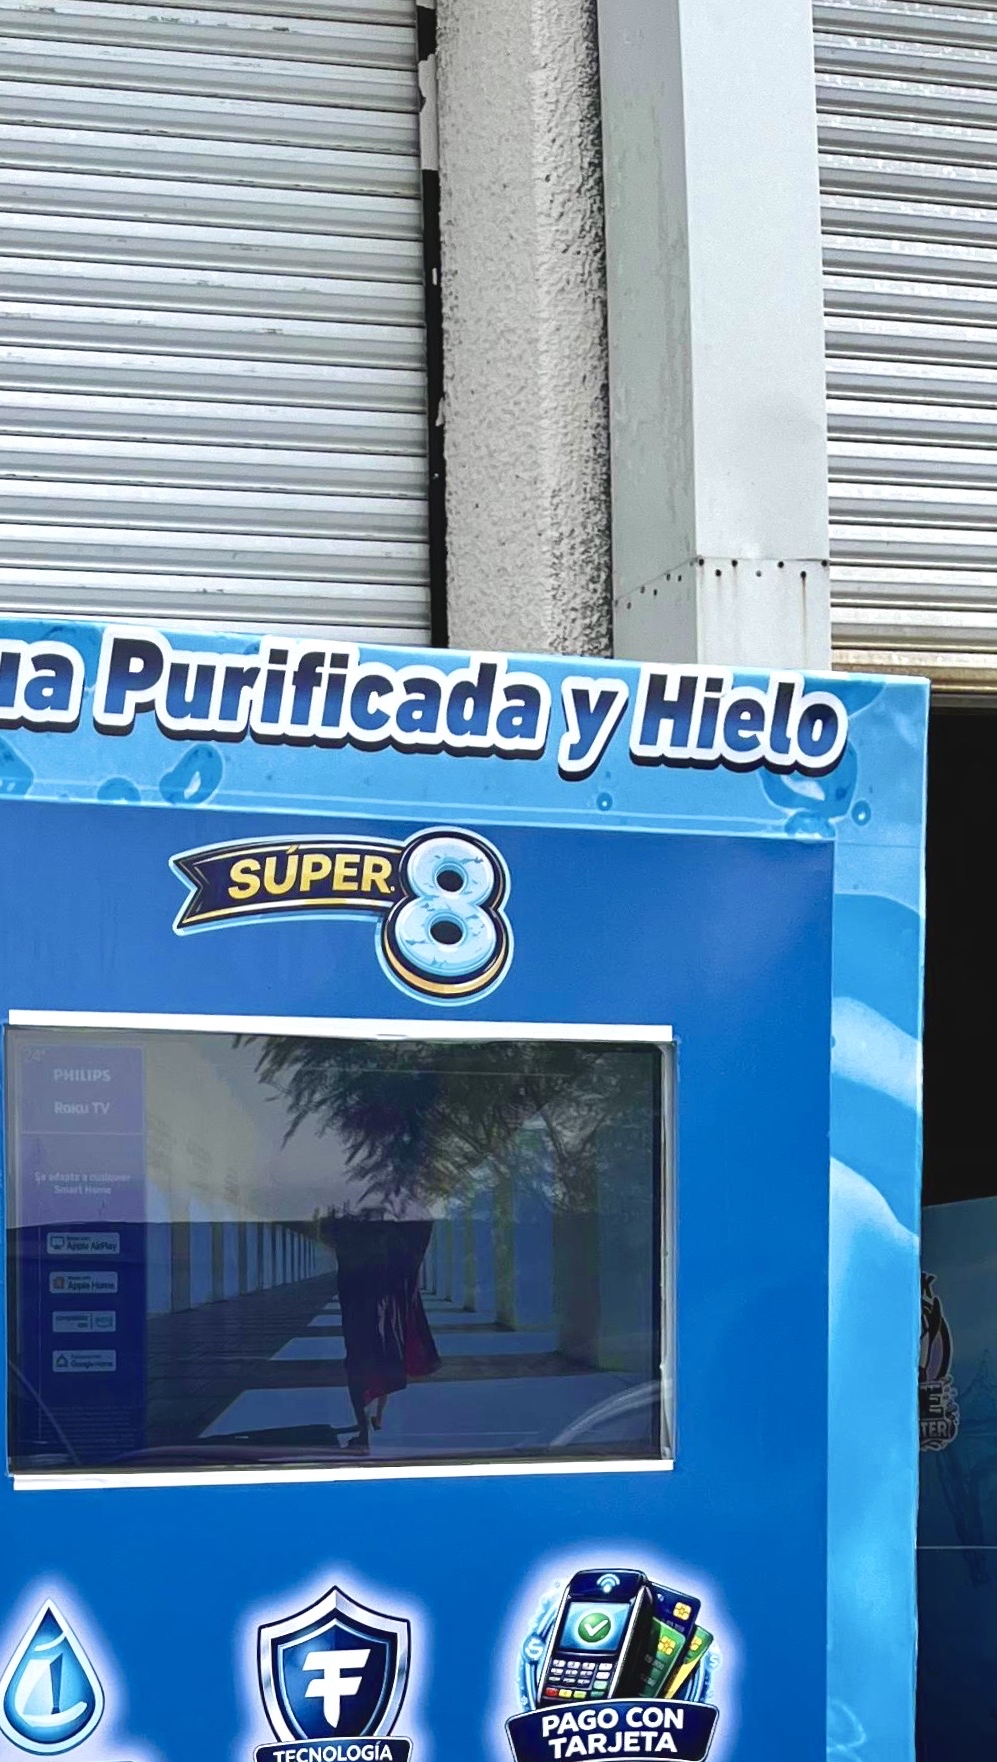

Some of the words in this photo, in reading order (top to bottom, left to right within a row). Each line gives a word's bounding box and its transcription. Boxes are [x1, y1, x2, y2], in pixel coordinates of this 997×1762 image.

[100, 634, 544, 741] Purificada
[567, 686, 621, 763] y
[637, 671, 841, 759] Hielo
[226, 844, 393, 900] SÚPER
[389, 834, 503, 990] 8
[53, 1068, 112, 1082] PHILIPS
[54, 1101, 89, 1114] Roku
[92, 1102, 110, 1114] TV
[541, 1707, 619, 1738] PAGO
[625, 1706, 685, 1730] CON
[548, 1731, 678, 1760] TARJETA
